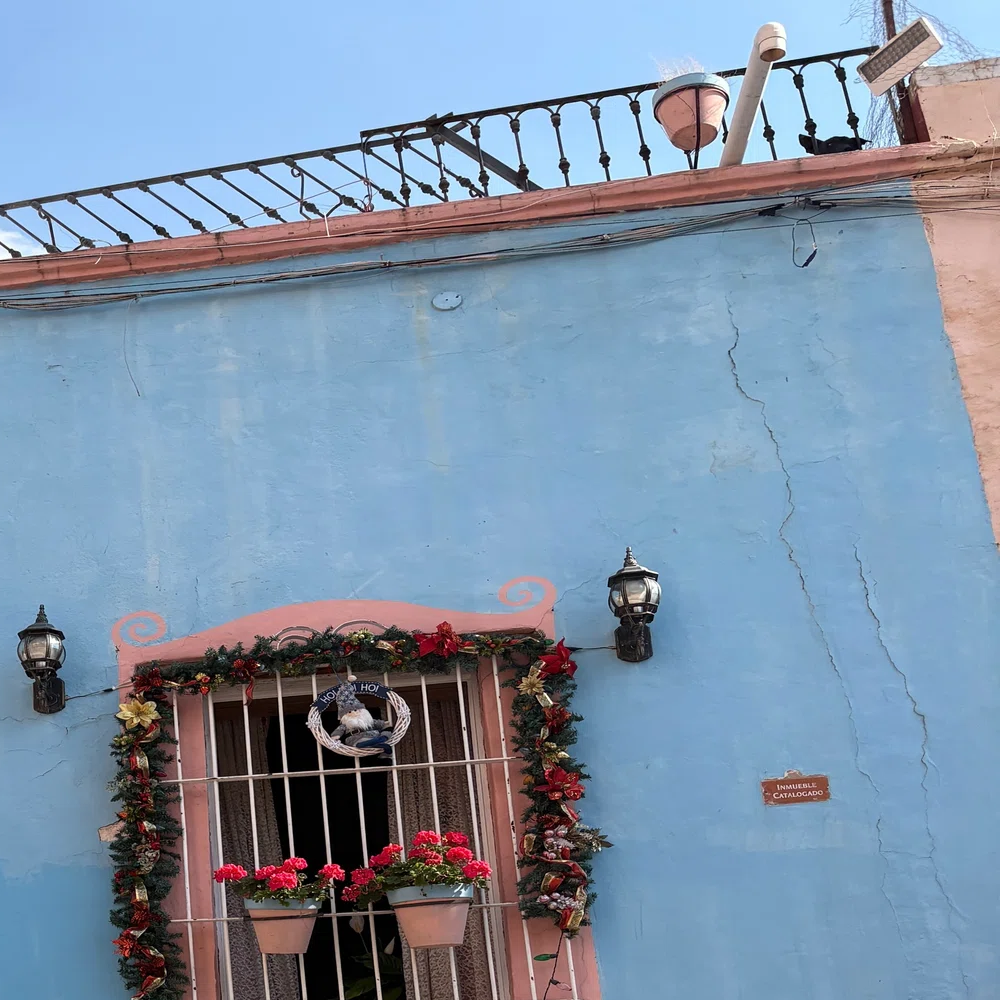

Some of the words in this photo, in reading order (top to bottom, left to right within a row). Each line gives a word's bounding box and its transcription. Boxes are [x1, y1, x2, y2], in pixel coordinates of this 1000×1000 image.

[361, 683, 379, 693] HO!
[777, 782, 817, 791] INMUEBLE
[773, 790, 824, 799] CATALOGADO
